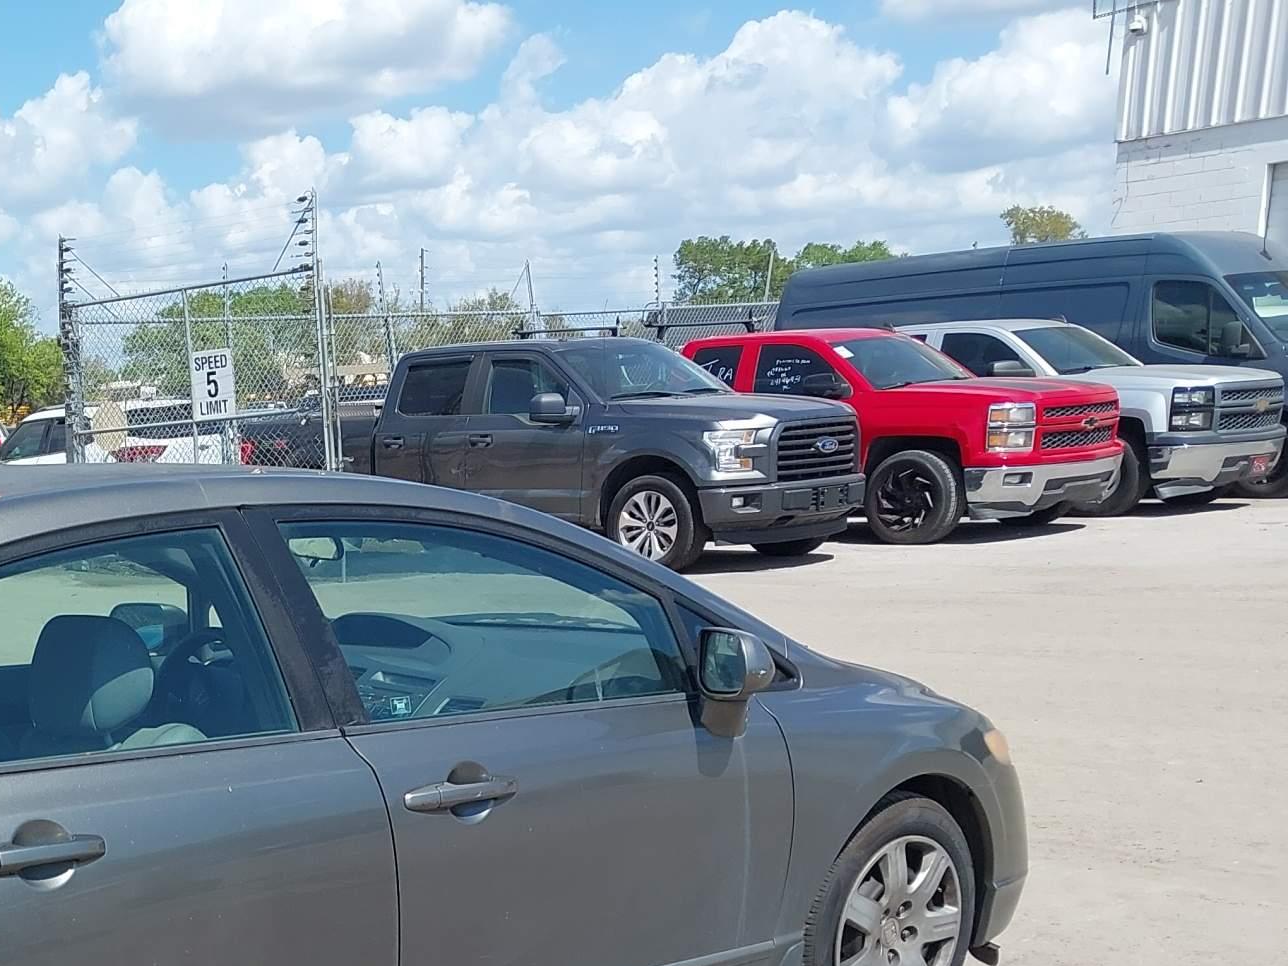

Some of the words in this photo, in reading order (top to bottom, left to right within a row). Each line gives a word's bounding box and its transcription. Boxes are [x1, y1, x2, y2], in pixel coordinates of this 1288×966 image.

[194, 354, 227, 372] SPEED
[206, 371, 219, 398] 5
[199, 400, 228, 416] LIMIT
